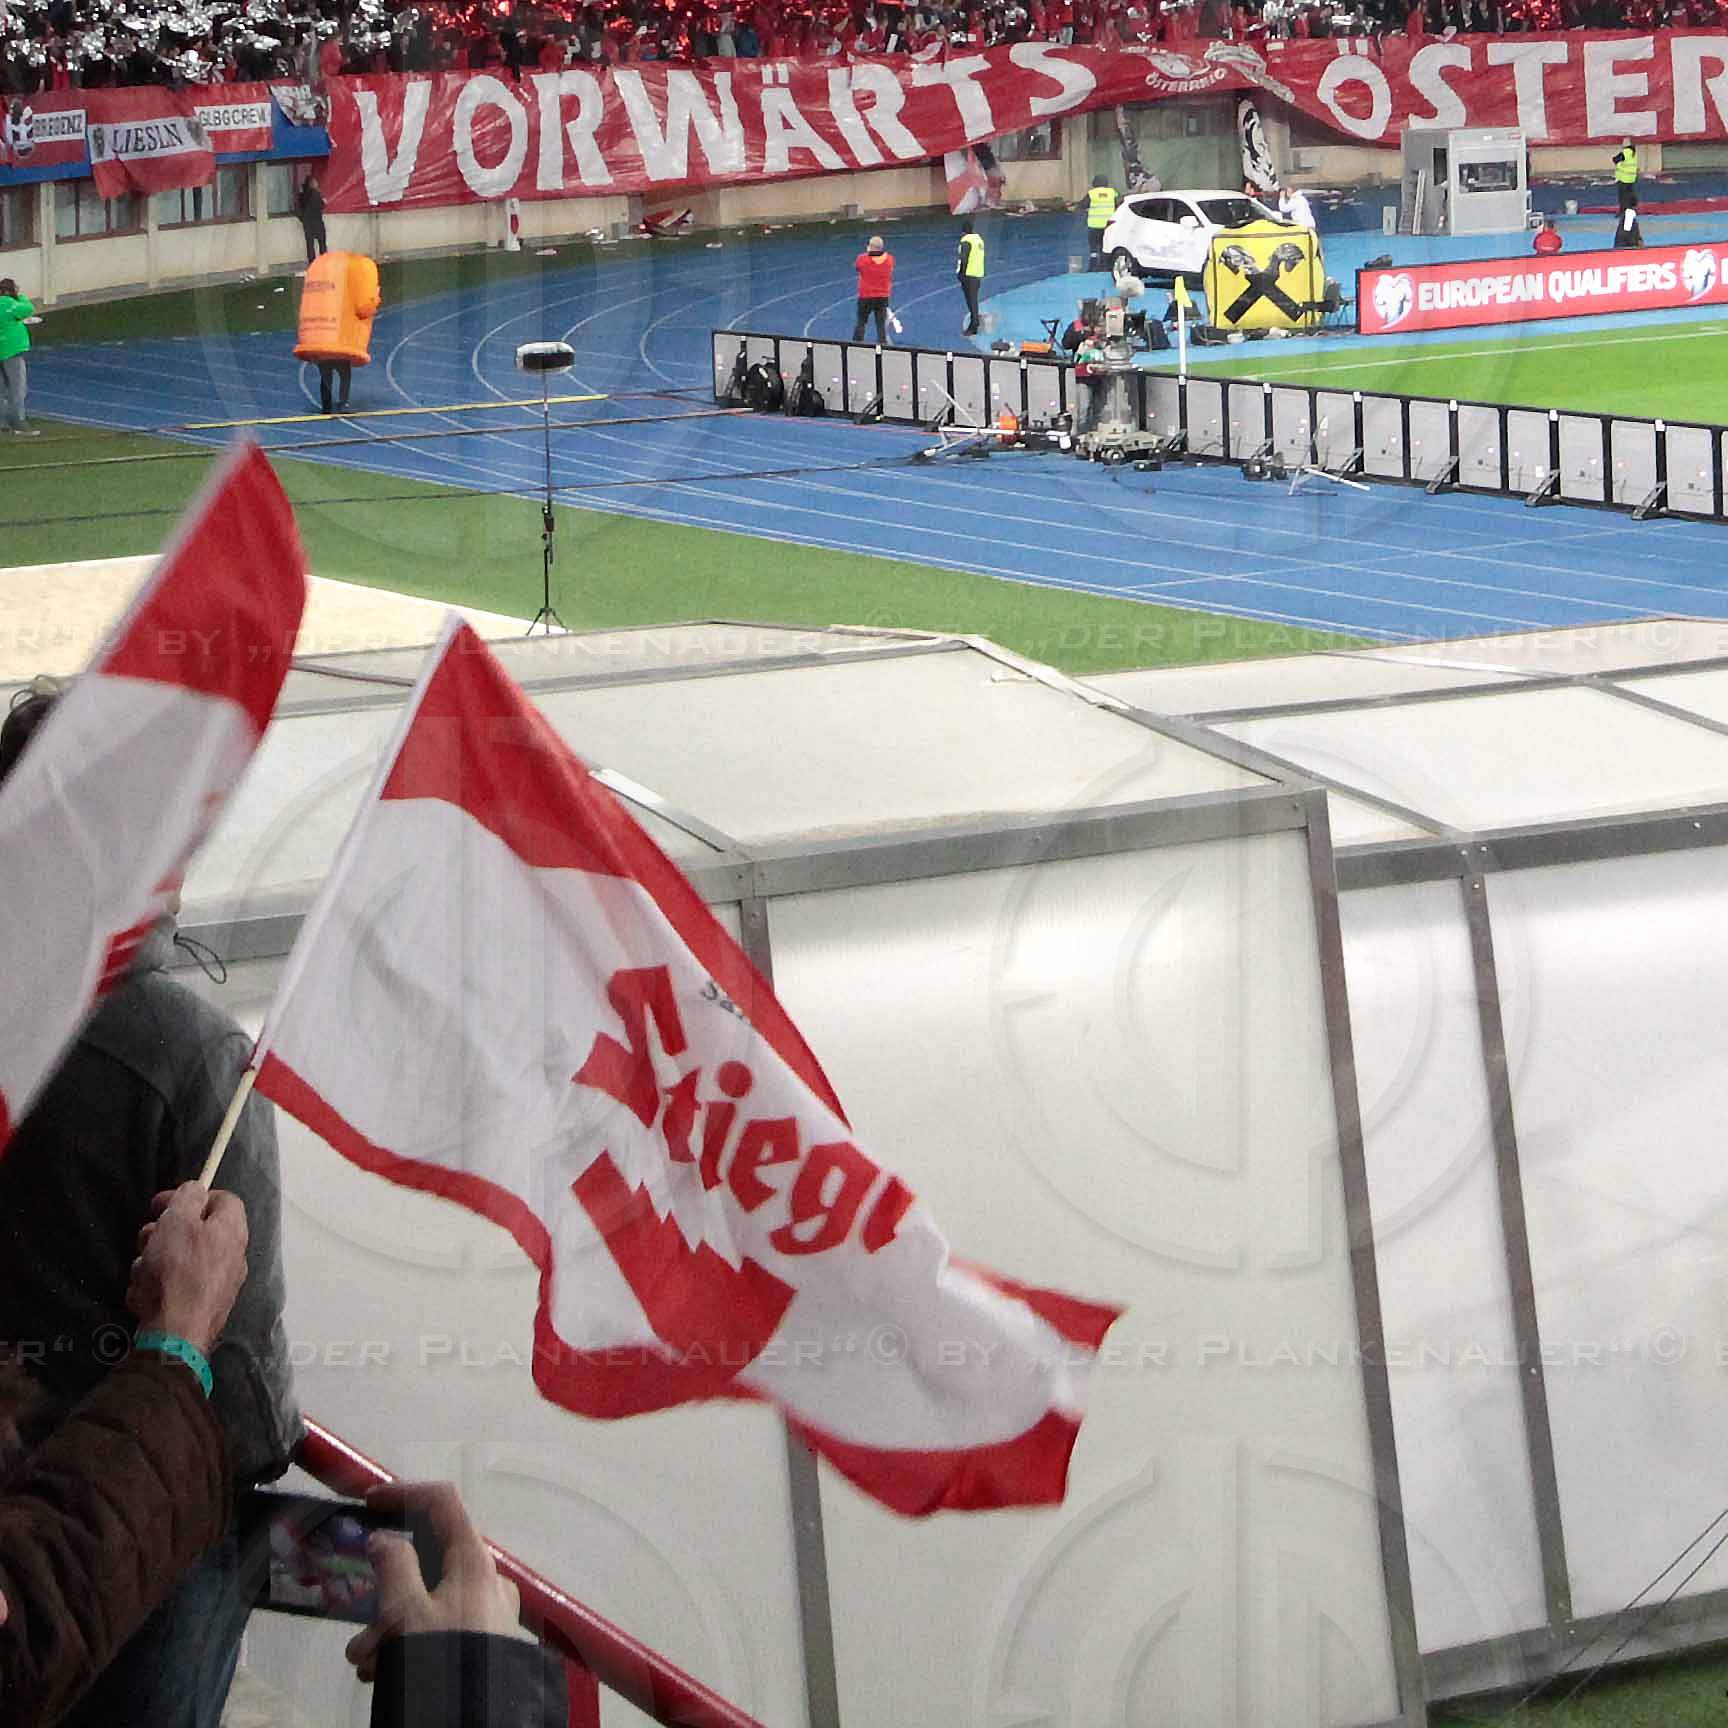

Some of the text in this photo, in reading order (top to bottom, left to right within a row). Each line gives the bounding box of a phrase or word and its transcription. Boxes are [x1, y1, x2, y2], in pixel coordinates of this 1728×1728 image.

[353, 41, 1097, 205] VORWÄRTS
[1418, 263, 1677, 311] EUROPEAN QUALIFIERS
